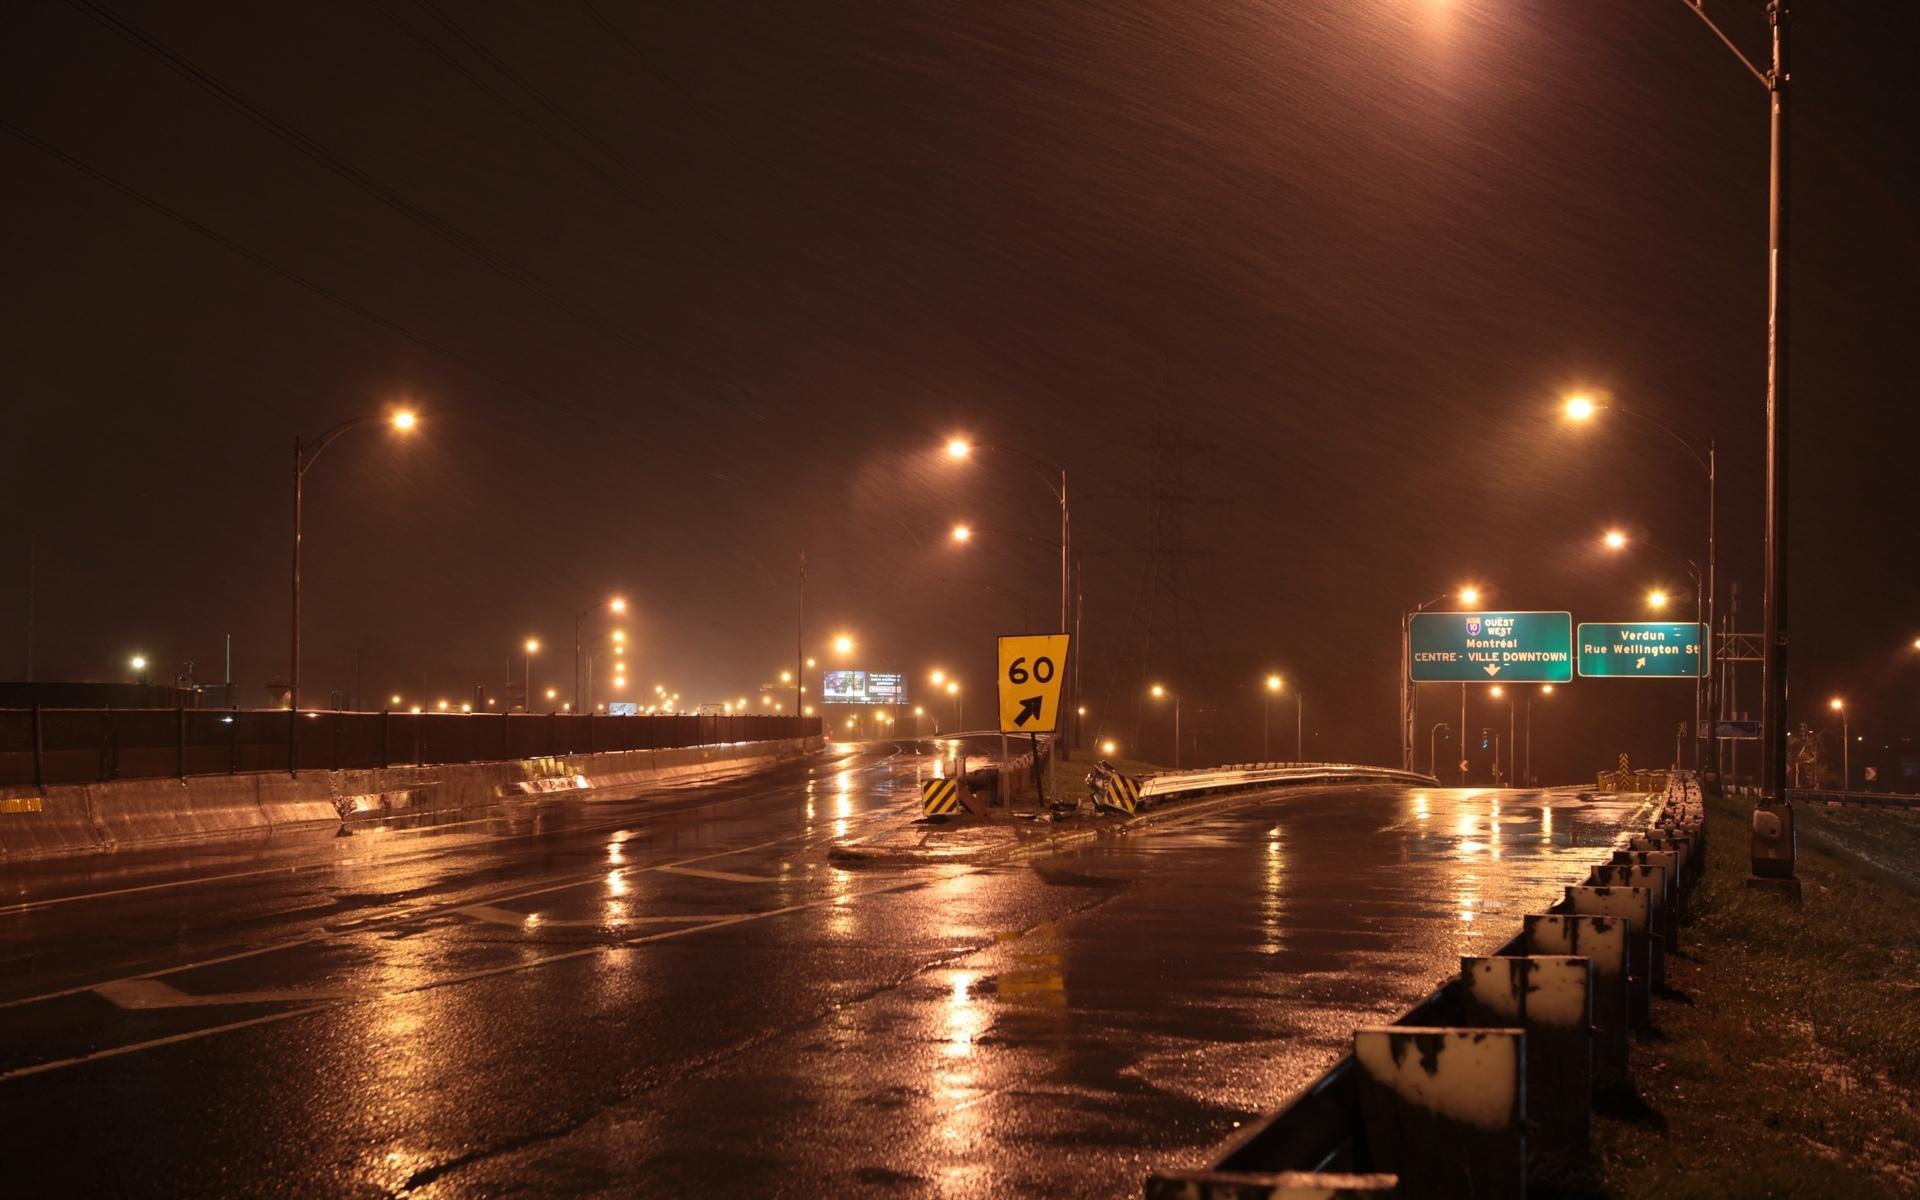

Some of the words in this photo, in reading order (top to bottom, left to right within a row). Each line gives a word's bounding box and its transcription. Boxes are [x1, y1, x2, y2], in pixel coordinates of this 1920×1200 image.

[1485, 618, 1515, 627] OUEST
[1469, 623, 1478, 632] 10
[1487, 627, 1512, 636] WEST
[1621, 631, 1665, 641] Verdun
[1466, 639, 1517, 648] Montréal
[1584, 644, 1608, 654] Rue
[1613, 644, 1679, 657] Wellington
[1415, 651, 1457, 661] CENTRE
[1468, 651, 1500, 661] VILLE
[1503, 651, 1568, 661] DOWNTOWN
[1008, 656, 1054, 685] 60
